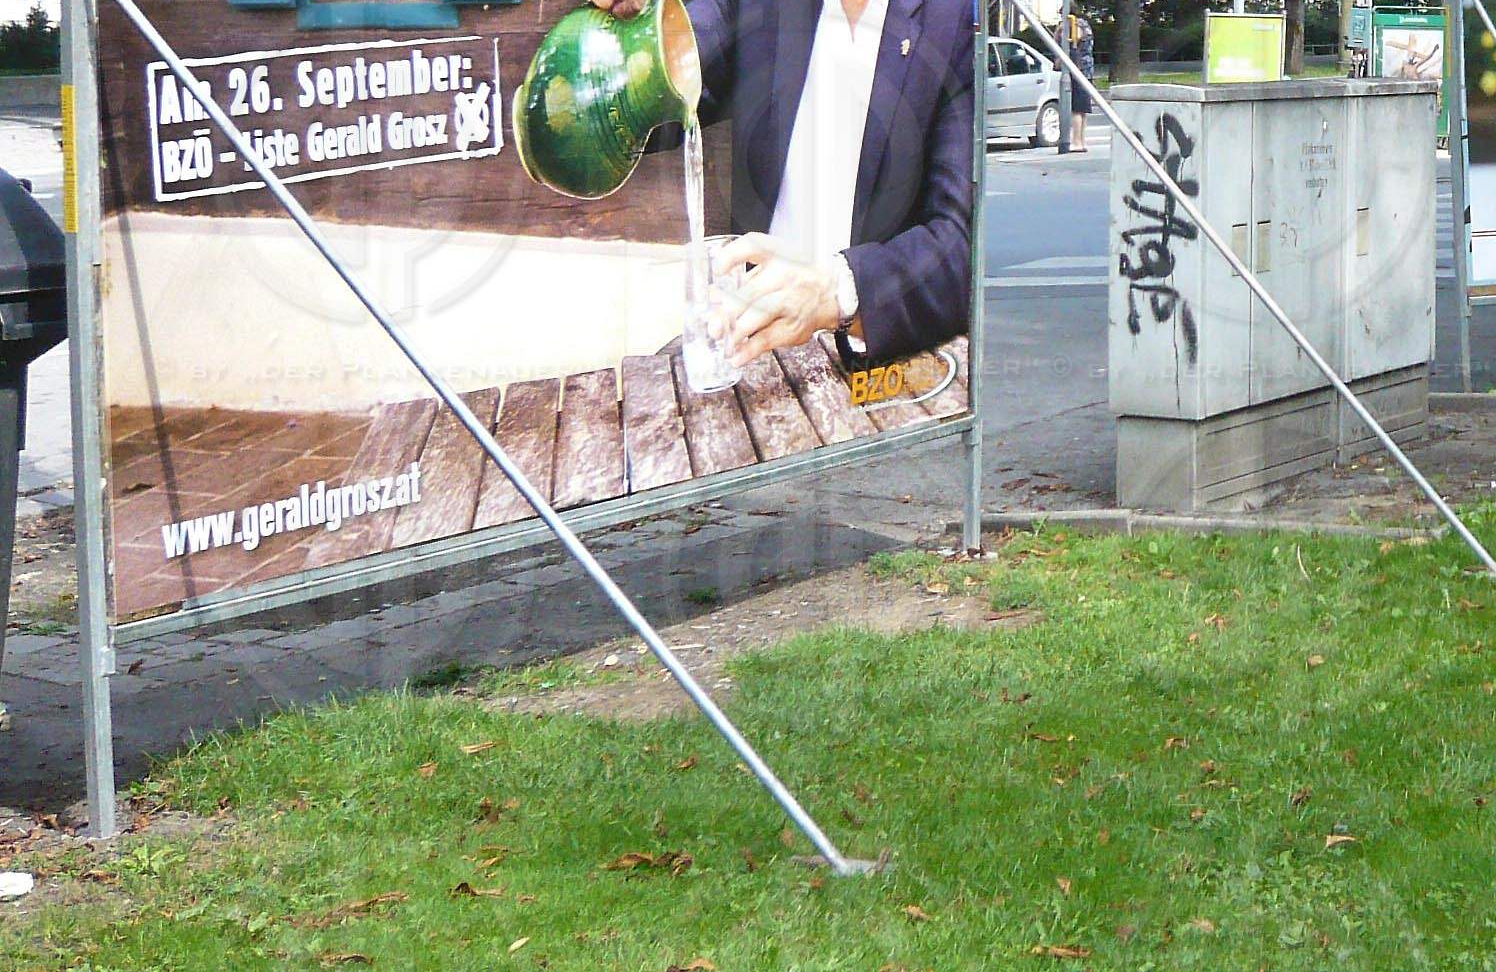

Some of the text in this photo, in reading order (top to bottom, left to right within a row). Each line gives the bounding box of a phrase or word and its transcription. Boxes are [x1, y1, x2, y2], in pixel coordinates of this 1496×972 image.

[159, 49, 473, 125] Am 26. September:
[162, 128, 213, 183] BZÖ
[243, 129, 300, 171] Liste
[307, 116, 382, 162] Gerald
[386, 110, 448, 151] Grosz
